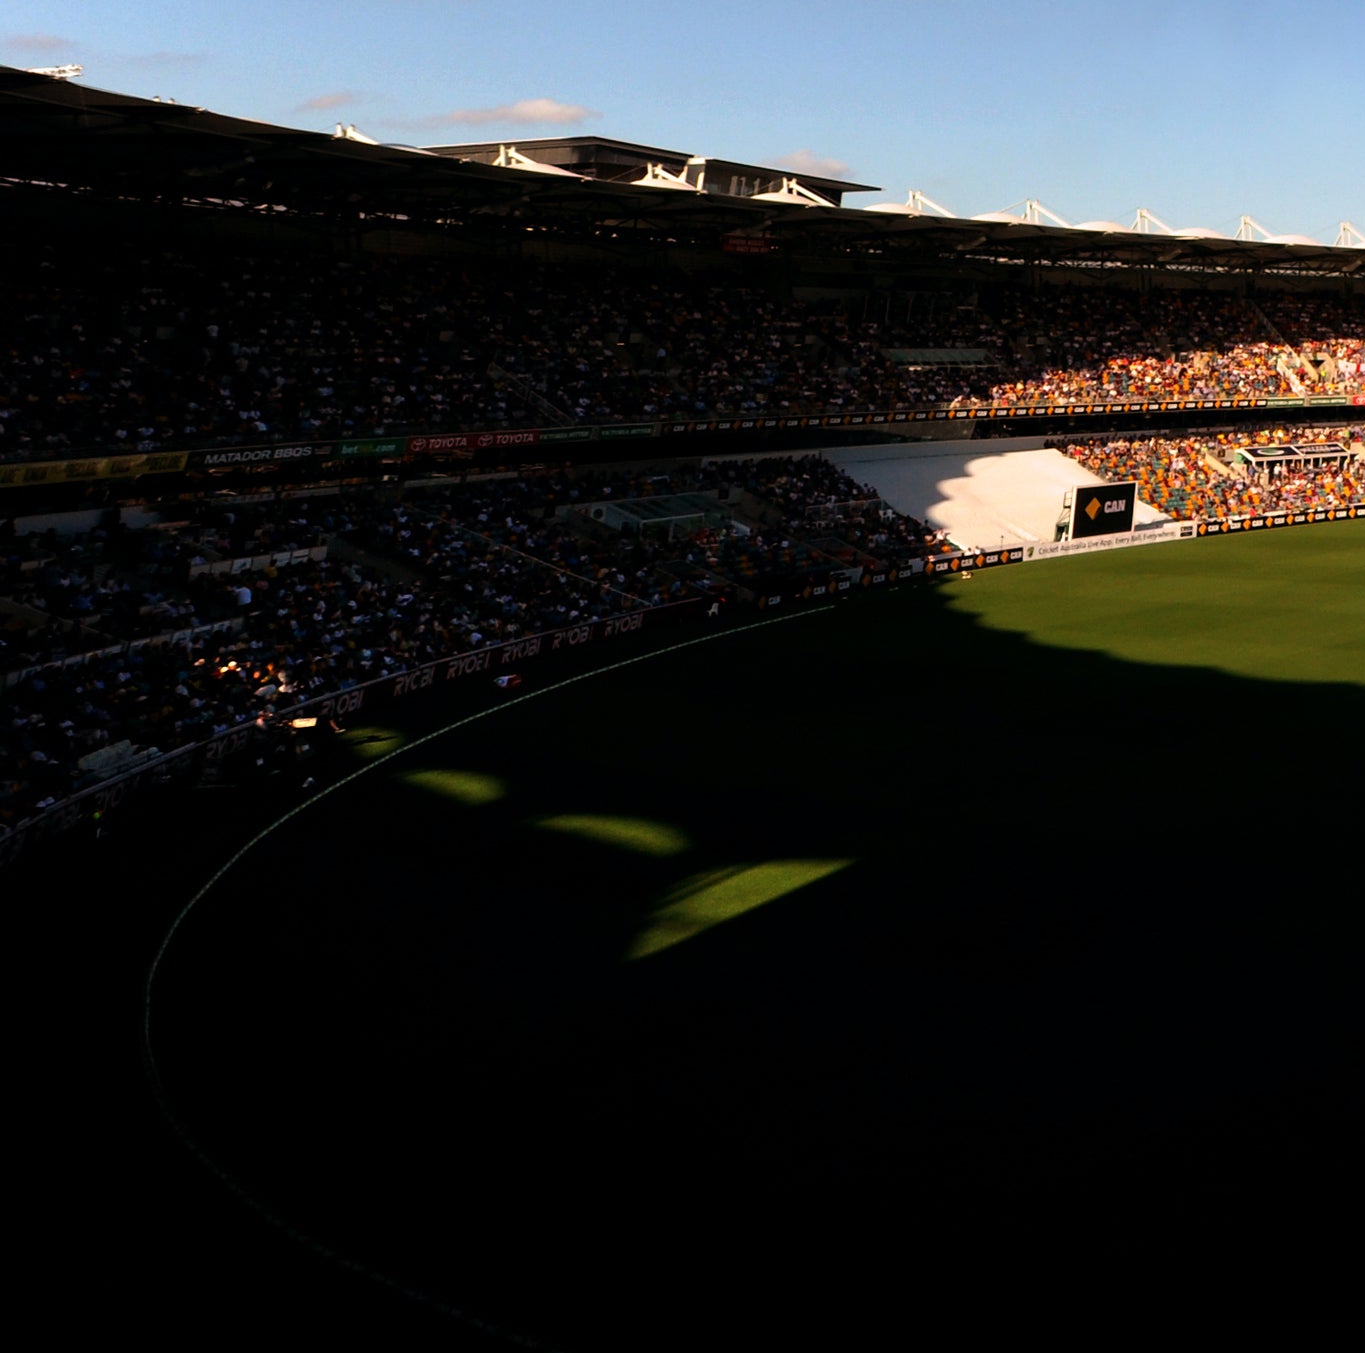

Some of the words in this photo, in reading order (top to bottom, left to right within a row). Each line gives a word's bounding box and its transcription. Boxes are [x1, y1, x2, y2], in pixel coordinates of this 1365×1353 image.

[429, 438, 467, 449] TOYOTA
[495, 433, 534, 445] TOYOTA
[204, 450, 271, 464] MATADOR
[1104, 500, 1126, 513] CAN
[1038, 546, 1059, 555] Cricket
[605, 611, 645, 637] RYOBI
[552, 626, 593, 649] RYOBI
[500, 638, 541, 665] RYOBI
